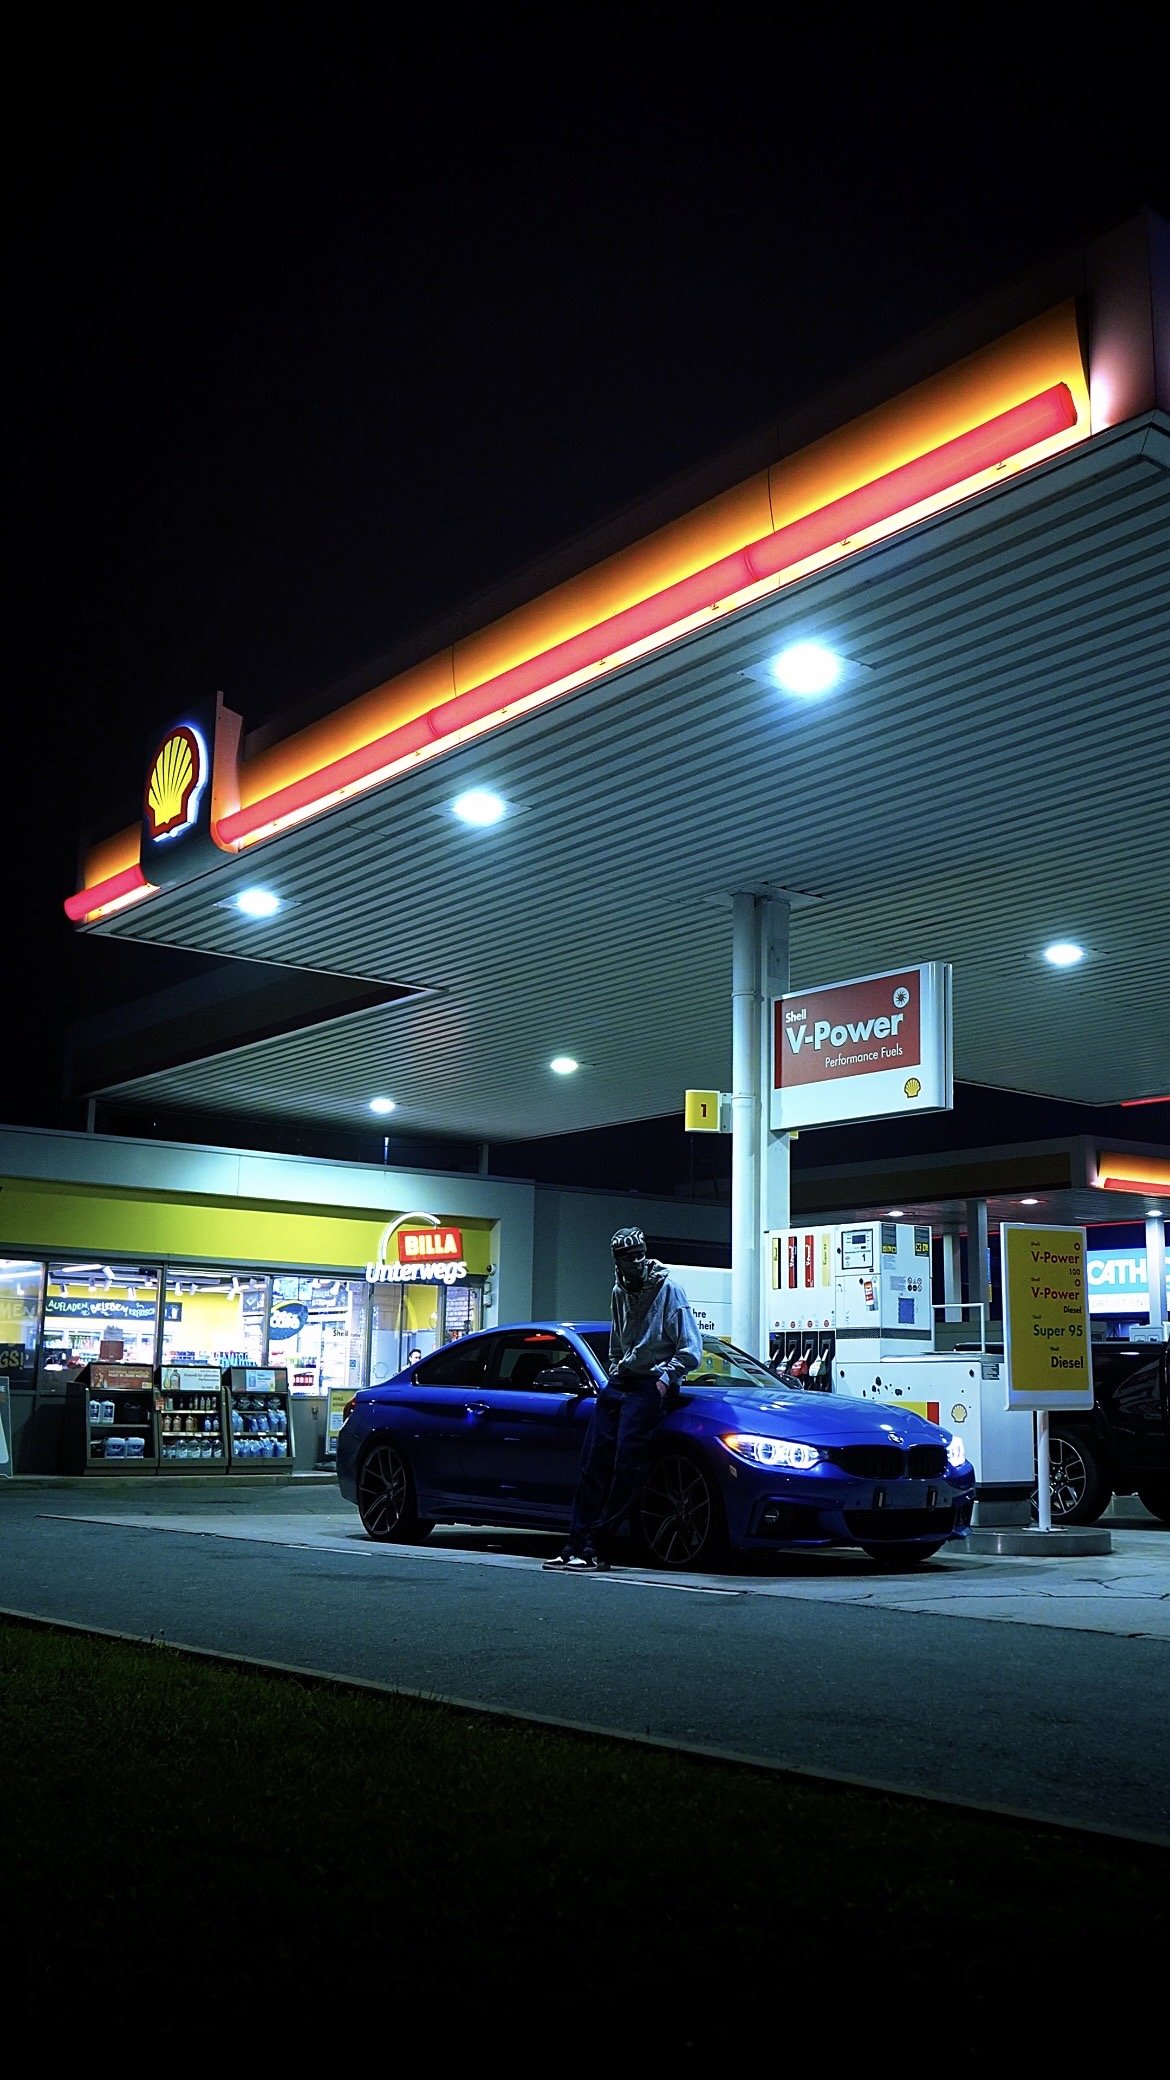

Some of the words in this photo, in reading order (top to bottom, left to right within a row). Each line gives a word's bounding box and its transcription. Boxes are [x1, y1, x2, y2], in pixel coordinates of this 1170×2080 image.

[785, 1008, 807, 1024] Shell
[785, 1012, 904, 1055] V-Power
[825, 1051, 879, 1069] Performance
[881, 1043, 903, 1059] Fuels
[700, 1103, 707, 1118] 1
[404, 1233, 458, 1256] BILLA
[1031, 1250, 1080, 1264] V-Power
[1068, 1268, 1081, 1276] 100
[1086, 1258, 1148, 1286] CATH
[1031, 1286, 1080, 1300] V-Power
[692, 1307, 707, 1319] hre
[1063, 1305, 1082, 1314] Diesel
[697, 1319, 716, 1331] heit
[1033, 1324, 1065, 1339] Super
[1068, 1324, 1083, 1337] 95
[0, 1350, 25, 1371] GS!
[1051, 1355, 1084, 1369] Diesel
